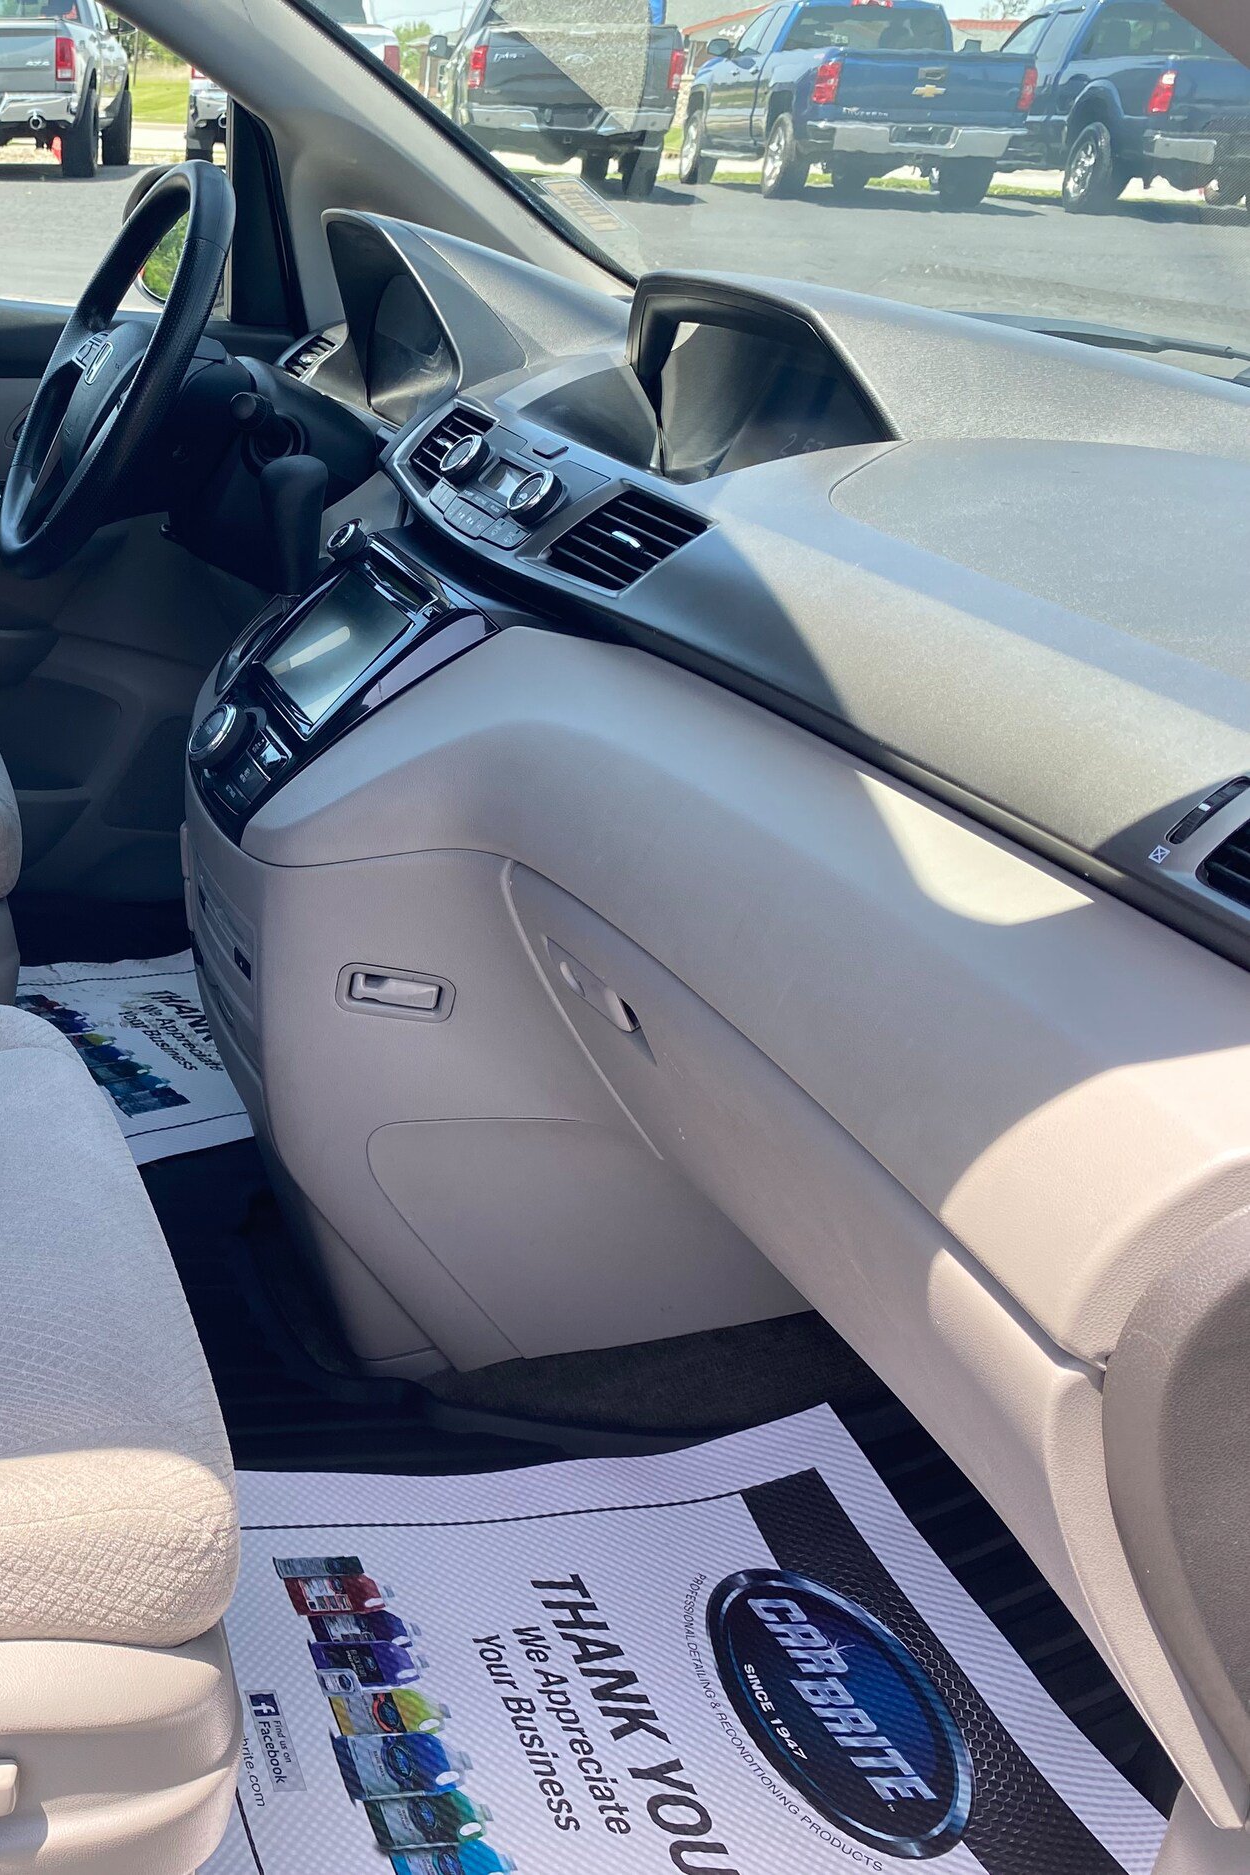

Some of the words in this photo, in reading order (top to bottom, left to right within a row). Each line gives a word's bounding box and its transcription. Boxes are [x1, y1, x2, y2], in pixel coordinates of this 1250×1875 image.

[118, 1010, 150, 1030] Your
[142, 1030, 198, 1071] Business
[138, 1004, 163, 1017] We
[155, 1018, 224, 1072] Appreciate
[682, 1572, 708, 1641] PROFESSIONAL
[747, 1598, 849, 1674] CAR
[687, 1642, 717, 1699] DETAILING
[273, 1720, 286, 1739] Find
[472, 1634, 520, 1691] Your
[501, 1696, 581, 1832] Business
[512, 1626, 552, 1663] We
[534, 1668, 632, 1835] Appreciate
[530, 1573, 672, 1745] THANK
[627, 1758, 740, 1875] YOU
[710, 1700, 721, 1710] &
[743, 1663, 776, 1713] SINCE
[770, 1717, 808, 1760] 1947
[790, 1676, 939, 1801] BRITE
[242, 1733, 266, 1808] brite.com
[258, 1721, 288, 1784] Facebook
[279, 1740, 288, 1750] us
[283, 1753, 292, 1763] on
[716, 1711, 800, 1816] RECONDITIONING
[800, 1815, 884, 1872] PRODUCTS
